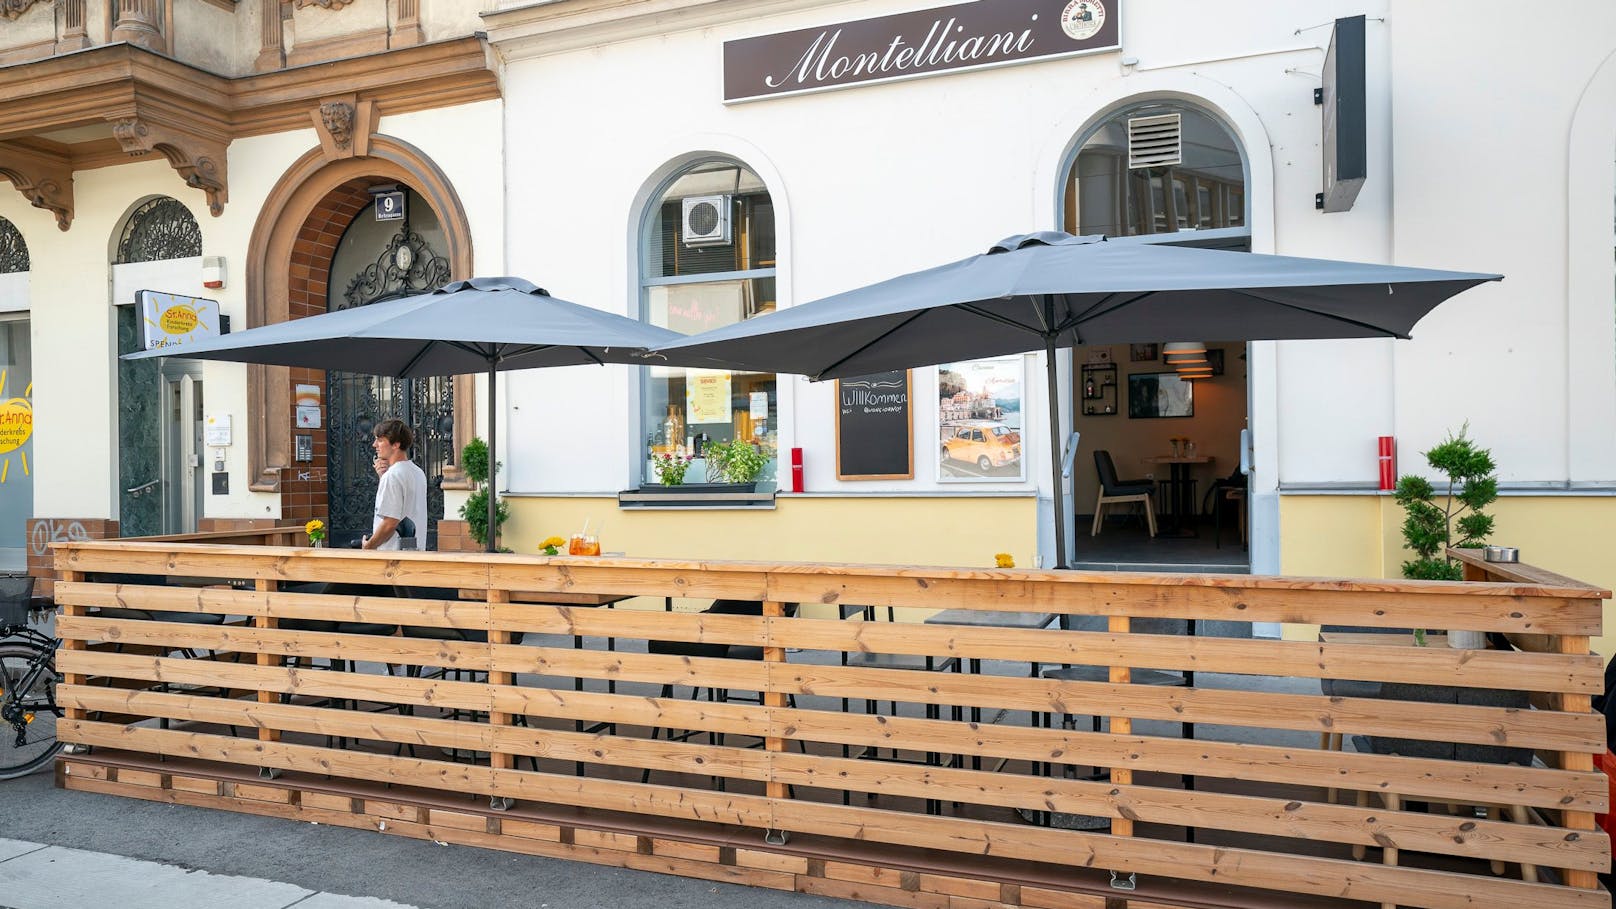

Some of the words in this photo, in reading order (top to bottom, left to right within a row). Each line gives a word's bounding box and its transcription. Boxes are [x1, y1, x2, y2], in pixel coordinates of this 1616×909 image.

[1062, 1, 1079, 22] BIRRA
[765, 13, 1038, 88] Montelliani
[384, 197, 394, 212] 9
[0, 427, 26, 436] derkrebs
[0, 437, 20, 446] schung
